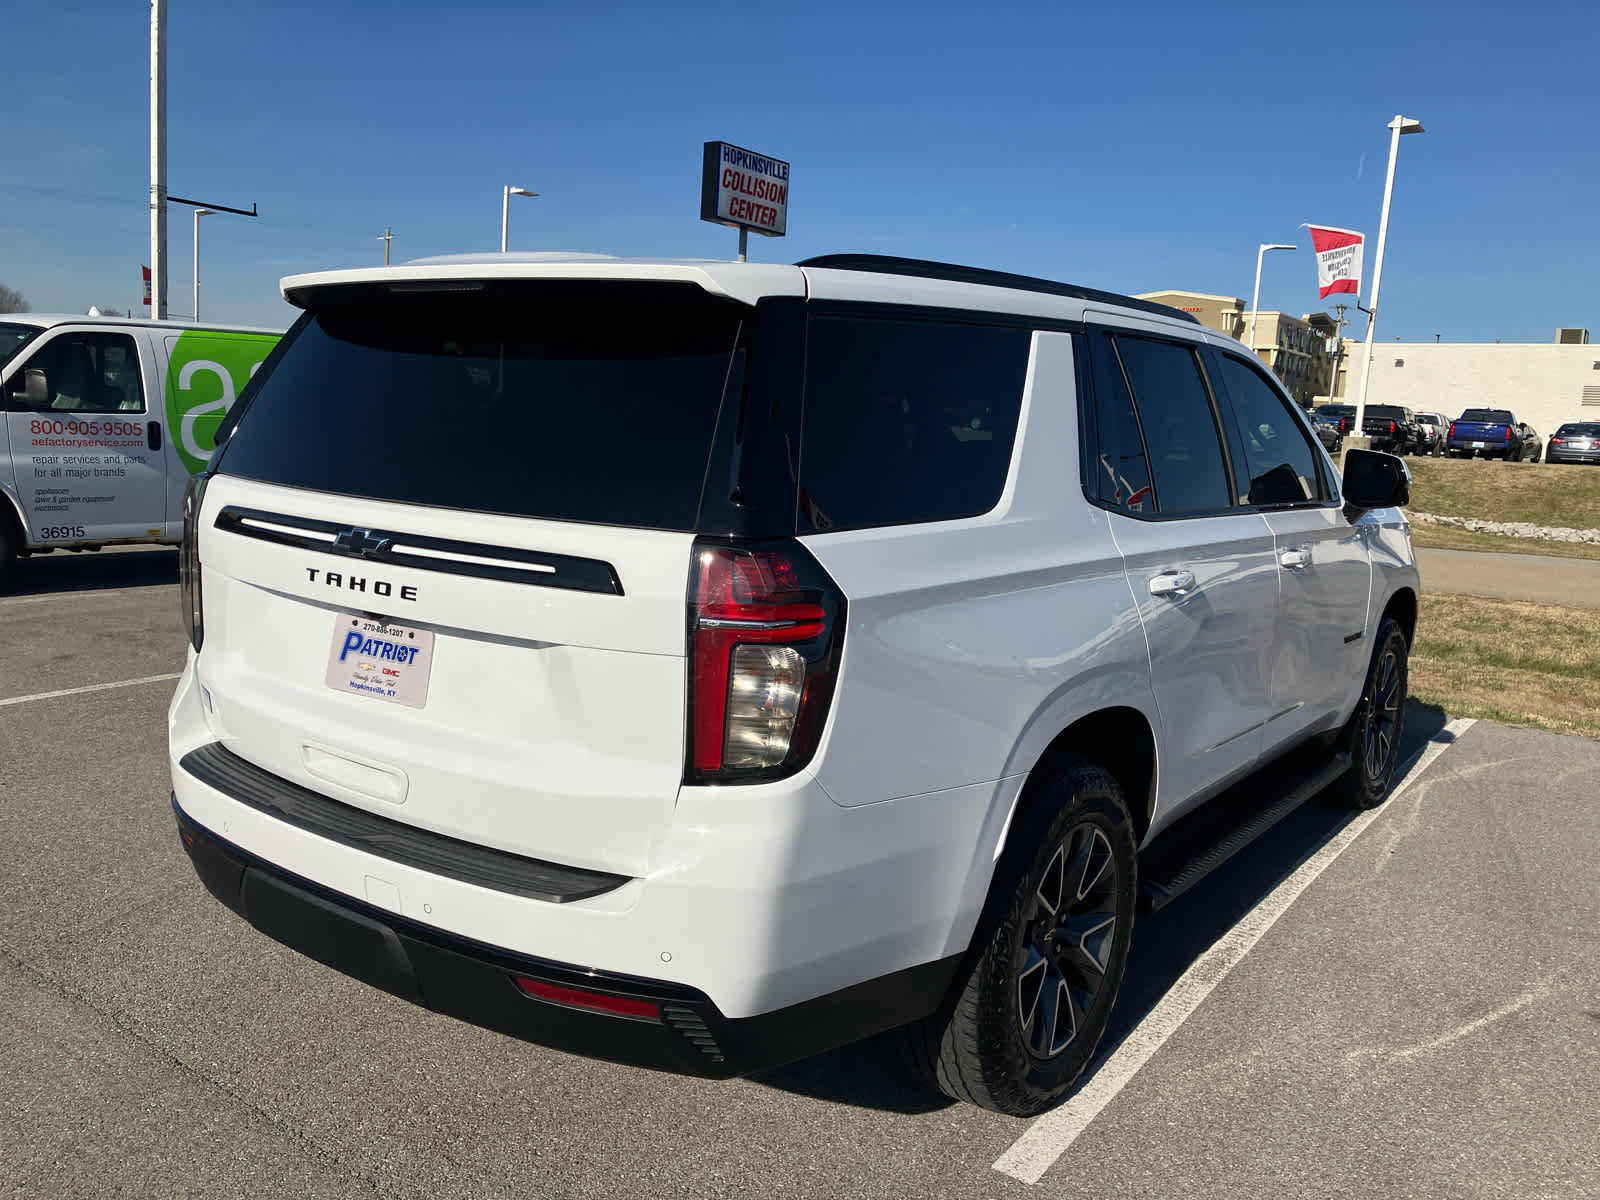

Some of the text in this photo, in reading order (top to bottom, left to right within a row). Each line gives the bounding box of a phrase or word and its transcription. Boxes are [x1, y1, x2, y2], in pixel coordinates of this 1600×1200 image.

[723, 146, 788, 181] HOPKINSVILLE
[722, 168, 786, 205] COLLISION
[729, 197, 777, 227] CENTER
[31, 437, 144, 448] aefactoryservice.com
[32, 454, 146, 465] repair services and parts
[34, 467, 126, 479] for all major brands
[41, 525, 85, 539] 36915
[306, 567, 418, 601] TAHOE
[339, 631, 419, 665] PATRIOT
[382, 667, 401, 678] GMC
[387, 689, 397, 697] KY
